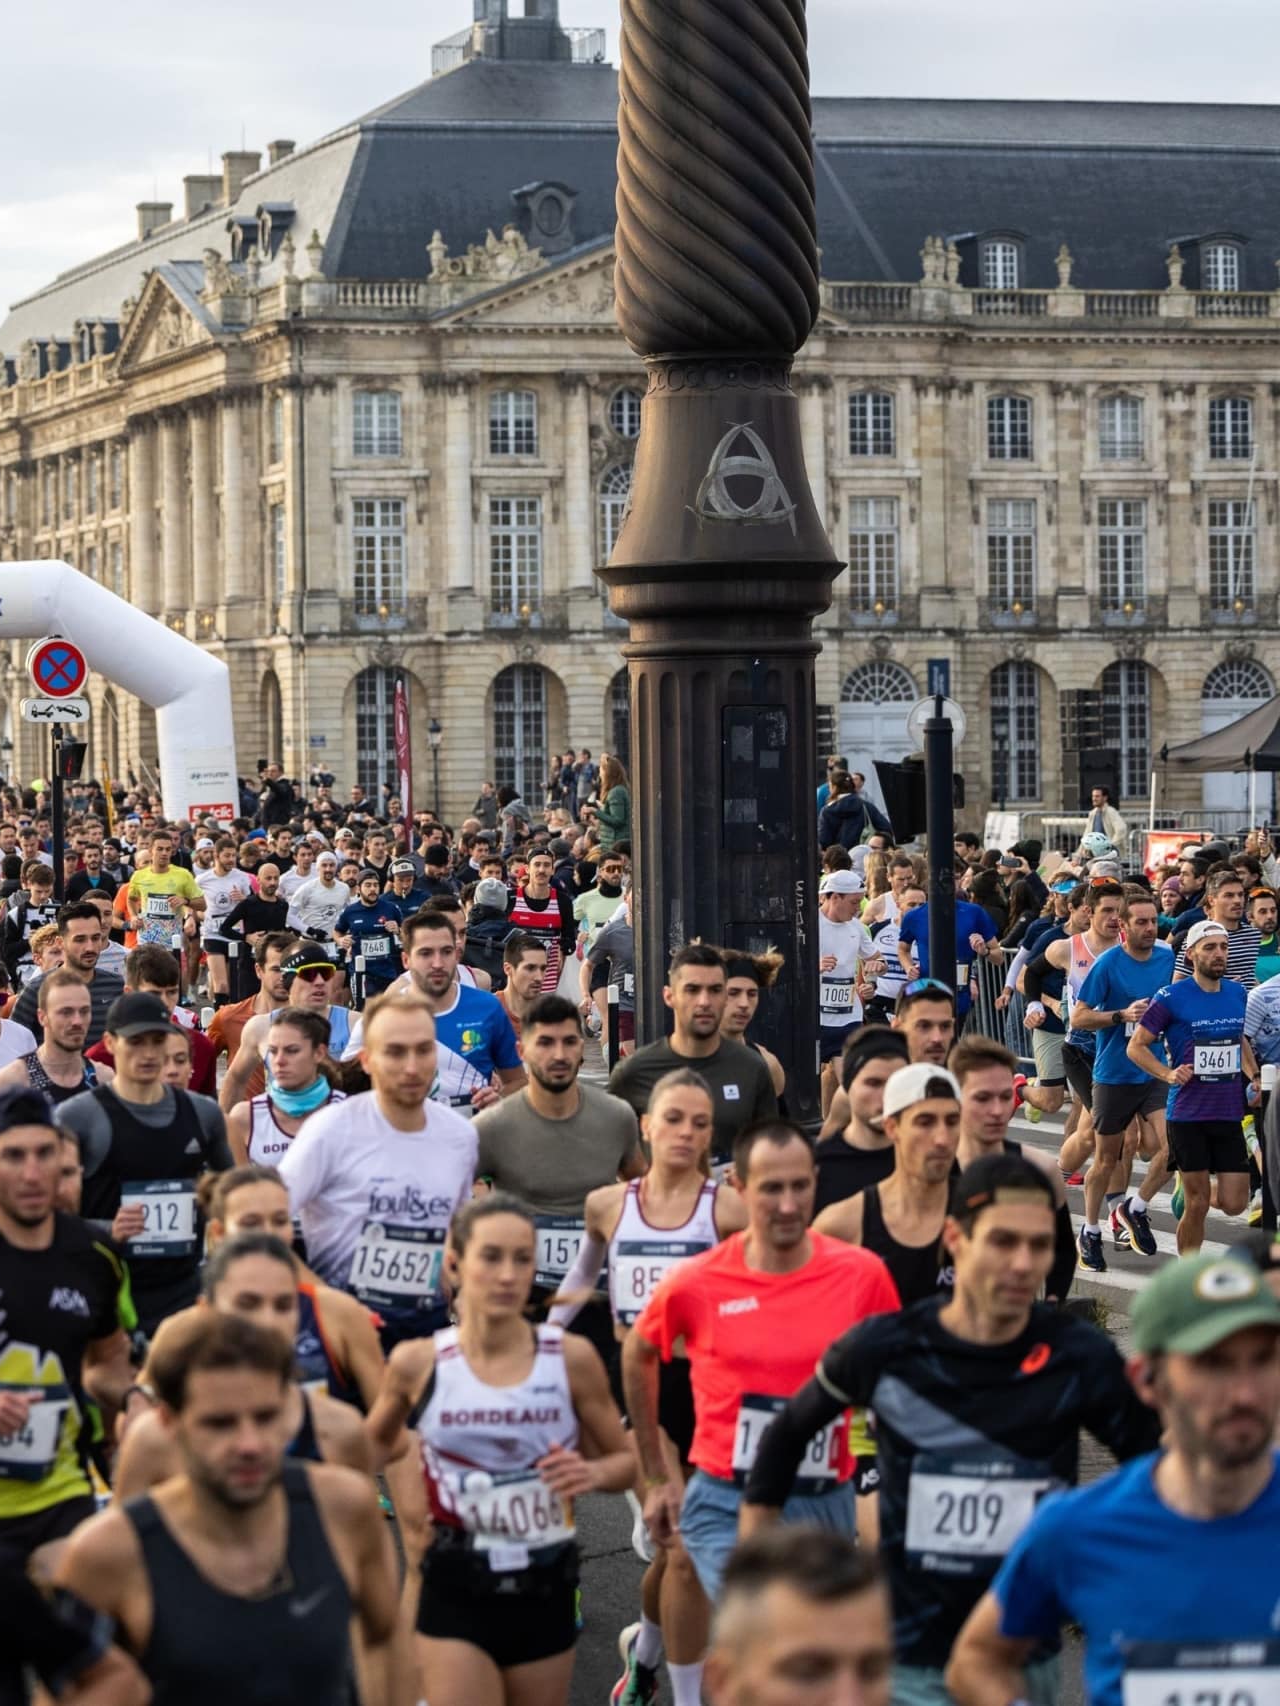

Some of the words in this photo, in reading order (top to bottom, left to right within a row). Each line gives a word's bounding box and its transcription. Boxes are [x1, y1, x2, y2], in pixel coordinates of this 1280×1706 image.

[149, 900, 169, 912] 1708
[363, 940, 385, 953] 7648
[824, 987, 850, 1003] 1005
[1199, 1051, 1231, 1069] 3461
[142, 1202, 179, 1232] 212
[357, 1245, 431, 1284] 15652
[439, 1408, 562, 1427] BORDEAUX
[935, 1490, 1004, 1539] 209
